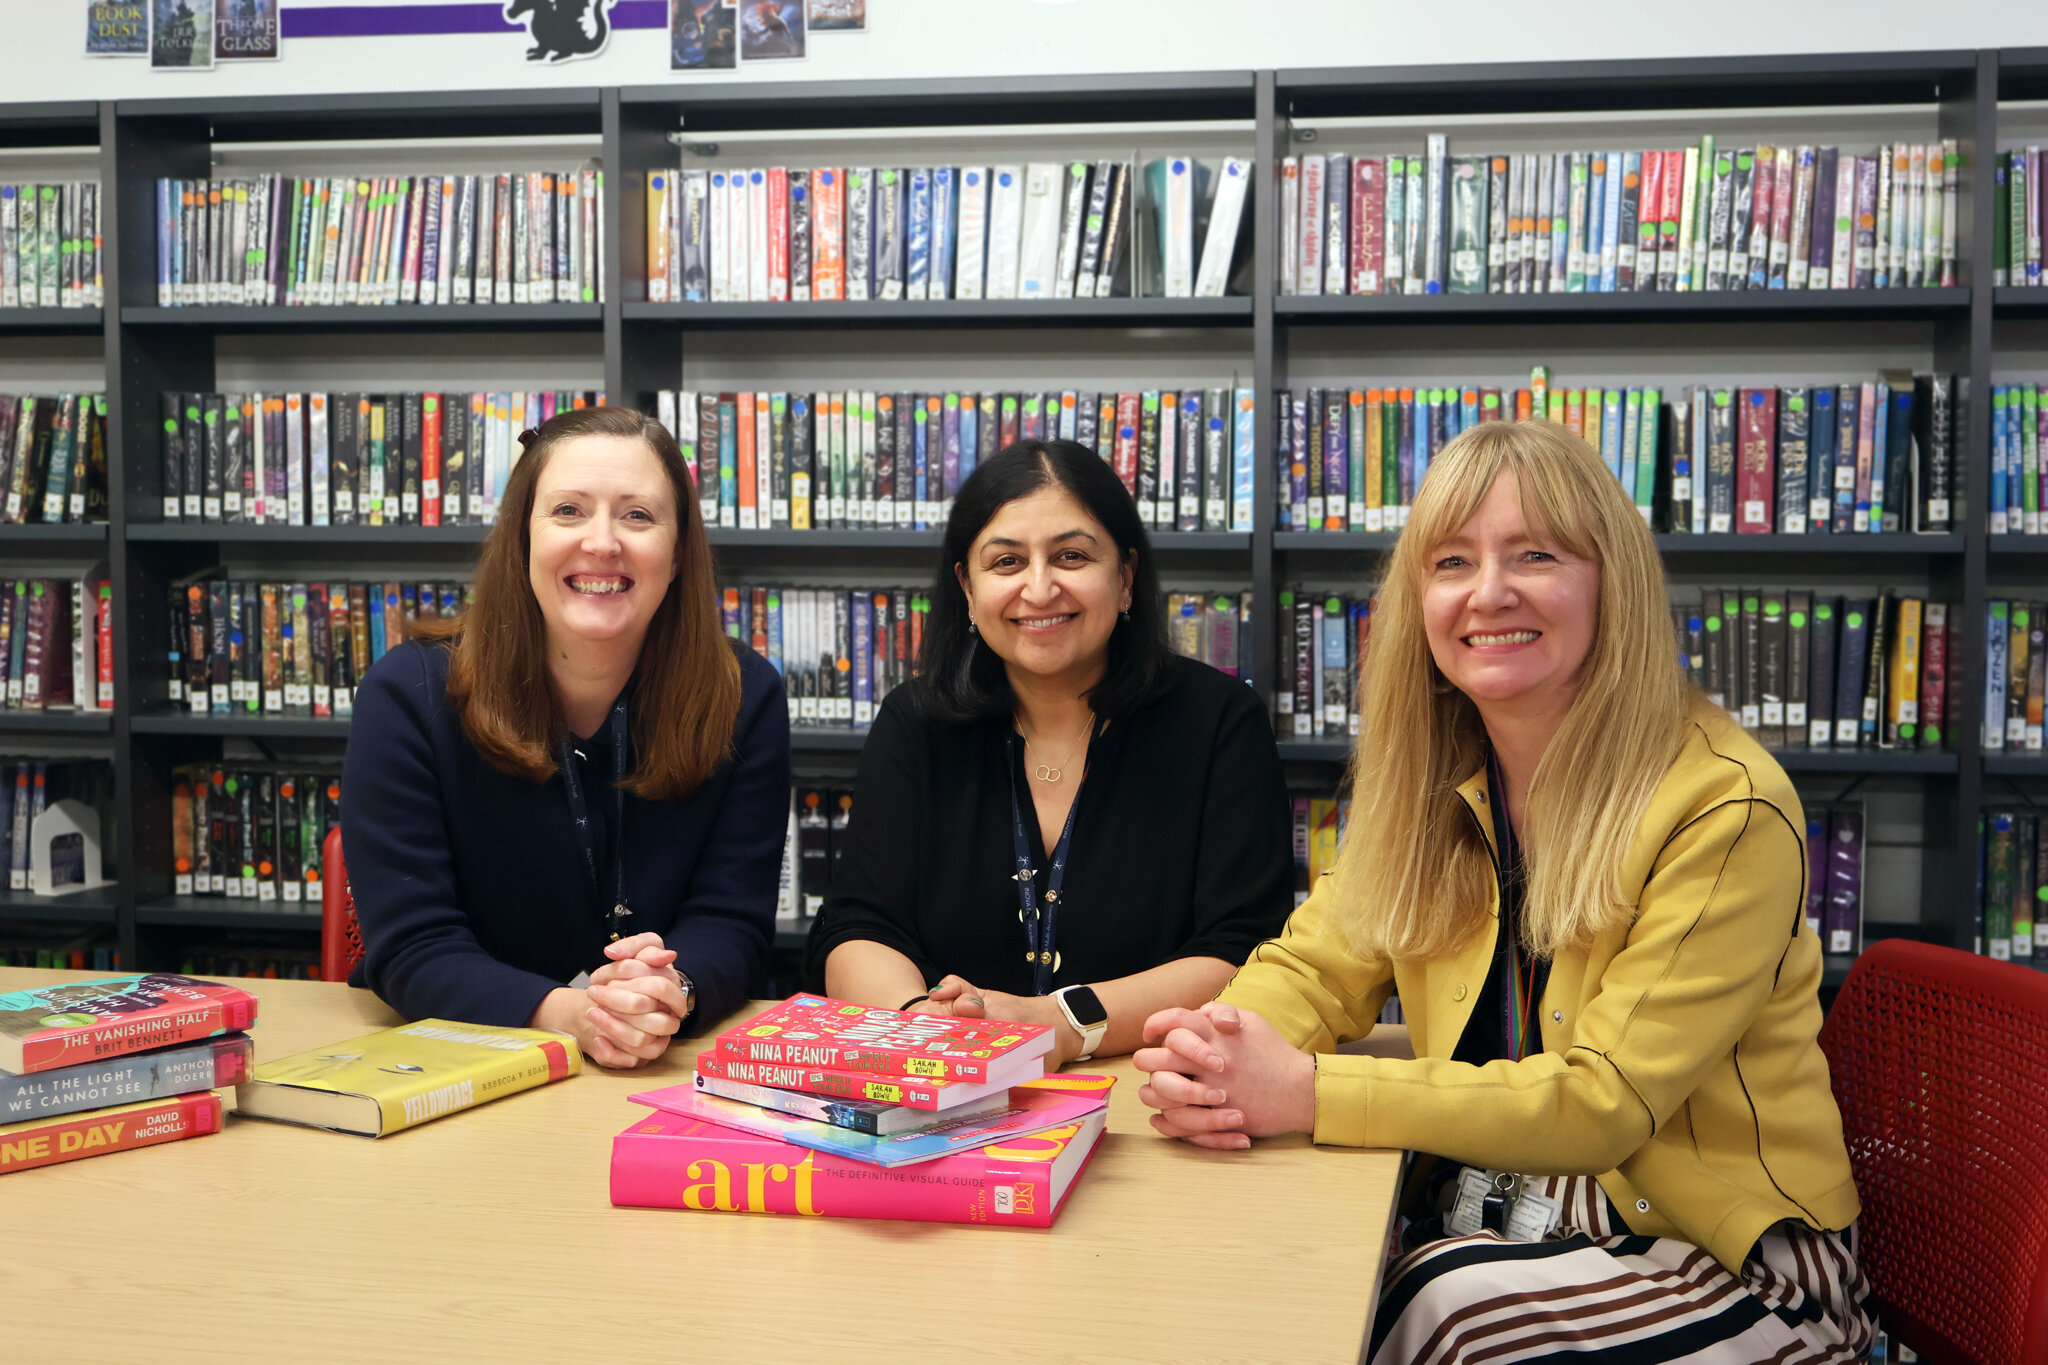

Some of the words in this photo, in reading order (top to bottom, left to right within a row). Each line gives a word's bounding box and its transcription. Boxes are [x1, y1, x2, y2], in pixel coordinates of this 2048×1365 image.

[96, 7, 143, 20] BOOK
[99, 23, 139, 36] DUST
[216, 18, 276, 36] THRONE
[222, 37, 272, 51] GLASS
[1305, 170, 1322, 218] gathering
[1361, 197, 1374, 271] ELDEST
[1304, 232, 1319, 266] shadow
[448, 400, 456, 447] KENNEDY
[1329, 404, 1342, 438] DEFY
[1311, 426, 1321, 487] THEODOSIA
[1330, 450, 1344, 486] NIGHT
[1710, 445, 1719, 473] DUST
[1744, 443, 1754, 470] DUST
[1756, 440, 1767, 473] BOOK
[896, 595, 905, 620] RED
[214, 617, 225, 655] THORN
[896, 621, 905, 659] WITCH
[63, 1036, 90, 1049] THE
[94, 1018, 172, 1040] VANISHING
[176, 1010, 210, 1026] HALF
[95, 1041, 123, 1055] BRIT
[128, 1029, 184, 1049] BENNETT
[164, 1058, 214, 1074] ANTHON
[750, 1043, 783, 1062] NINA
[786, 1046, 839, 1066] PEANUT
[845, 1051, 858, 1059] EPIC
[860, 1052, 891, 1062] WORLD
[846, 1060, 871, 1070] TOUR
[873, 1062, 891, 1071] ERA
[912, 1058, 937, 1068] SARAH
[17, 1084, 42, 1096] ALL
[52, 1078, 80, 1091] THE
[88, 1069, 134, 1086] LIGHT
[482, 1075, 518, 1092] REBECCA
[726, 1062, 756, 1081] NINA
[759, 1065, 805, 1088] PEANUT
[810, 1073, 824, 1082] EPIC
[824, 1074, 851, 1085] WORLD
[914, 1066, 934, 1076] BOWIE
[8, 1100, 33, 1112] WE
[40, 1088, 108, 1107] CANNOT
[116, 1082, 142, 1095] SEE
[812, 1082, 835, 1092] TOUR
[836, 1084, 852, 1095] ERA
[870, 1083, 893, 1094] SARAH
[873, 1092, 891, 1101] BOWIE
[402, 1079, 474, 1125] YELLOWFACE
[146, 1112, 180, 1126] DAVID
[0, 1137, 51, 1164] NE
[59, 1122, 126, 1154] DAY
[682, 1148, 825, 1216] art
[826, 1168, 845, 1179] THE
[848, 1170, 906, 1182] DEFINITIVE
[910, 1174, 948, 1185] VISUAL
[952, 1176, 985, 1188] GUIDE
[979, 1189, 987, 1222] EDITION
